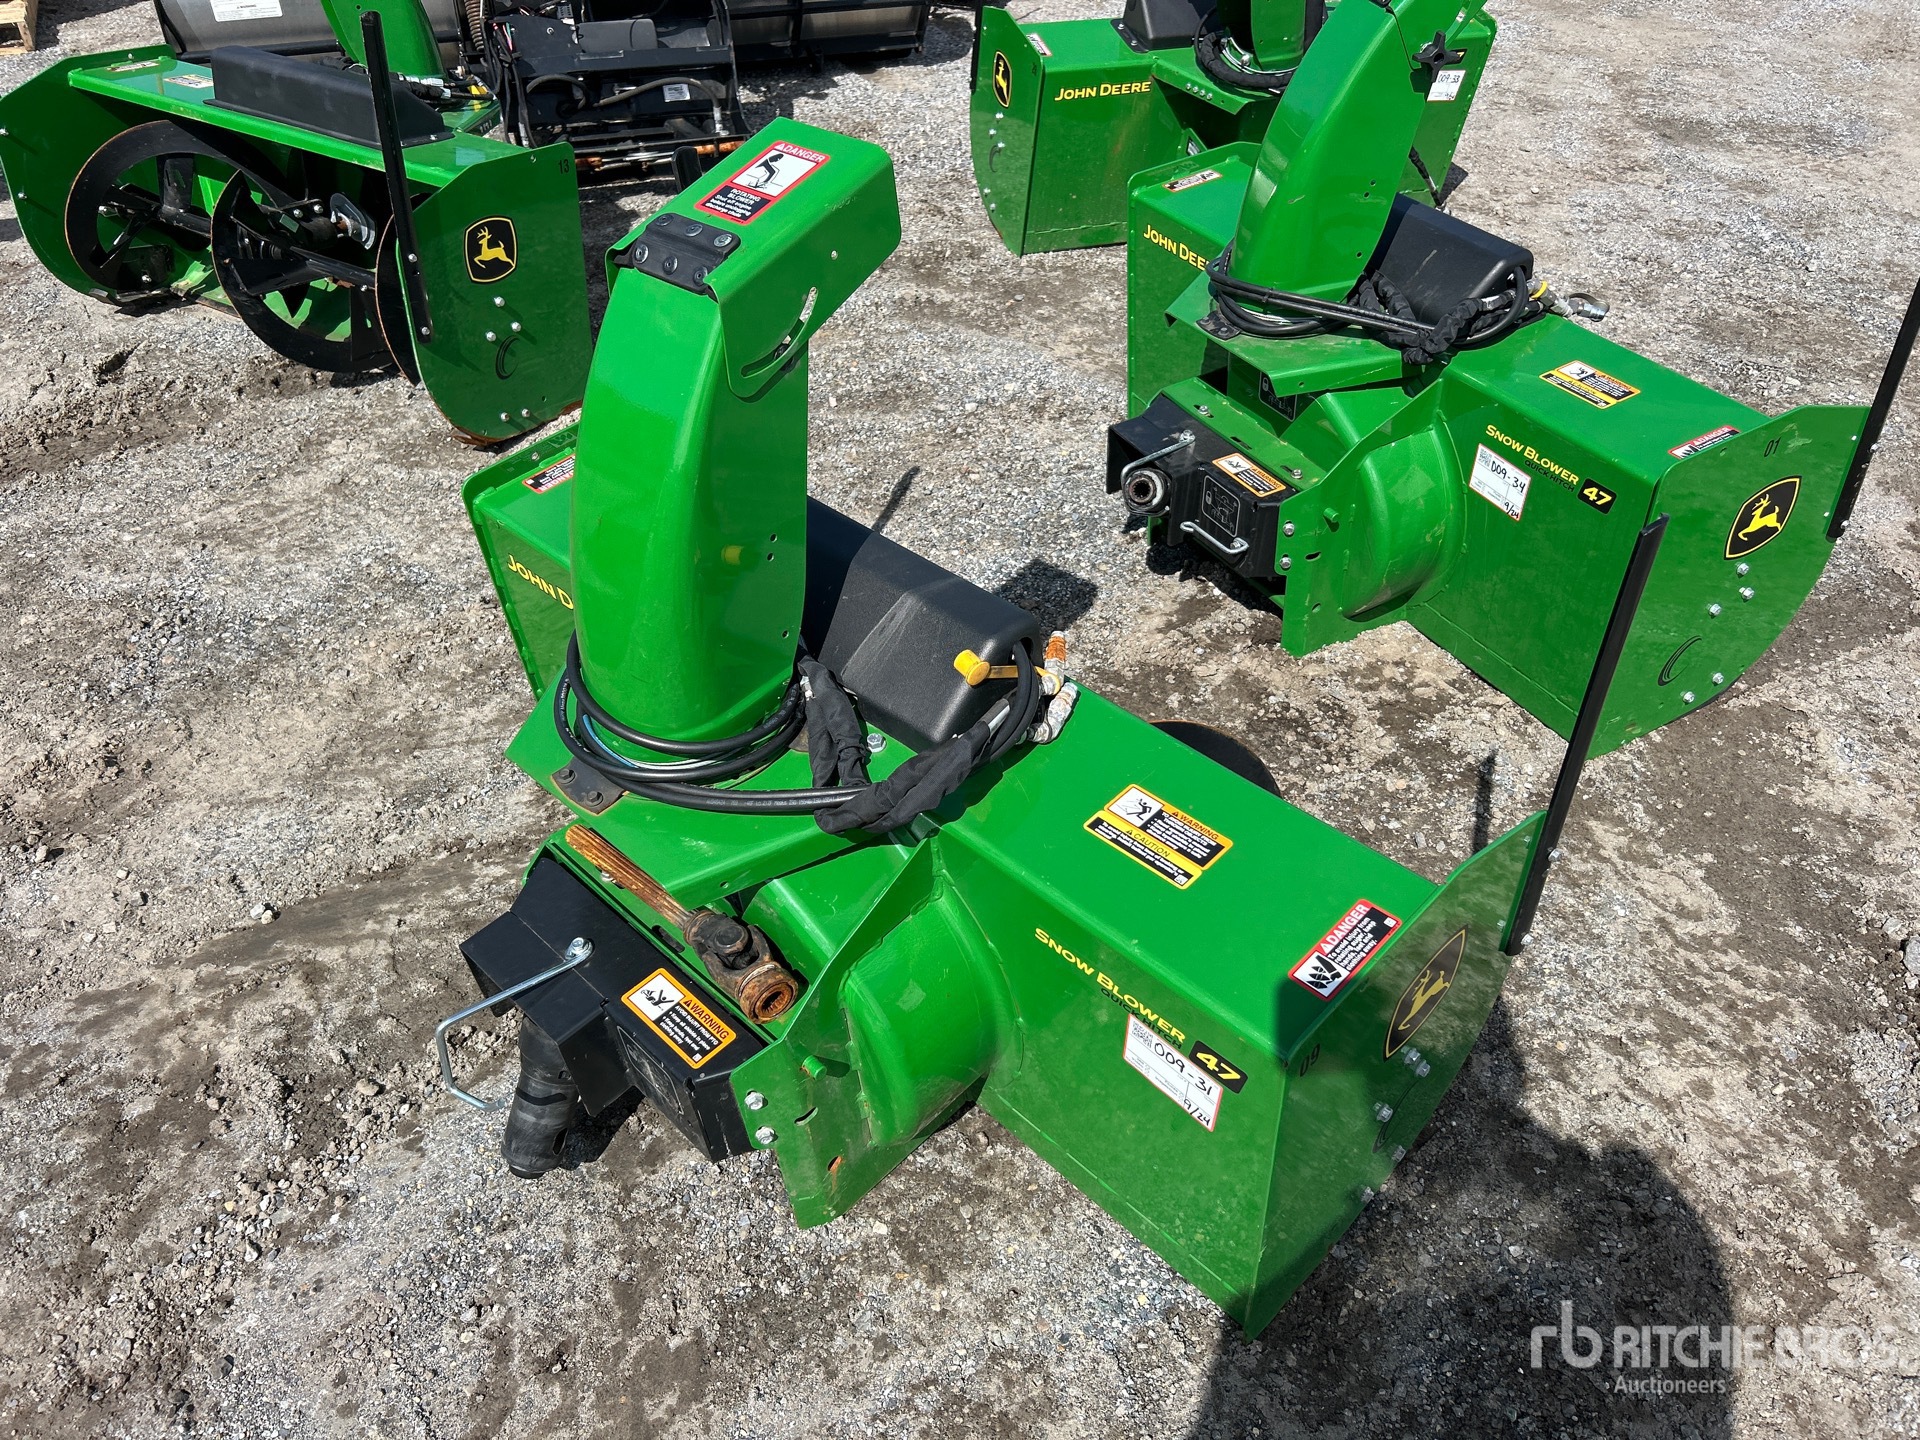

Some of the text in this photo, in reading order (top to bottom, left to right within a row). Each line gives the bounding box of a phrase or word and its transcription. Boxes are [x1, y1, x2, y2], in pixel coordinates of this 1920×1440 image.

[1055, 81, 1151, 101] JOHN DEERE
[558, 159, 570, 175] 13
[784, 145, 825, 162] DANGER
[727, 193, 754, 204] BLOWER
[1144, 225, 1210, 271] JOHN DEE
[1700, 427, 1730, 444] DANGER
[1764, 437, 1781, 457] 01
[1486, 424, 1524, 452] SNOW
[1524, 446, 1580, 485] BLOWER
[1524, 460, 1549, 478] QUICK
[1550, 475, 1575, 492] HITCH
[1583, 487, 1612, 506] 47
[508, 554, 557, 600] JOHN
[1180, 816, 1220, 840] WARNING
[1134, 833, 1170, 857] CAUTION
[1326, 904, 1369, 945] DANGER
[1334, 940, 1349, 953] avoid
[1346, 927, 1362, 942] injury
[1358, 917, 1370, 928] from
[1334, 945, 1354, 964] rotating
[1363, 921, 1378, 933] keep
[1354, 942, 1365, 952] feet
[1362, 933, 1373, 943] and
[1346, 951, 1366, 971] clothing
[1034, 928, 1094, 975] SNOW
[1096, 972, 1186, 1043] BLOWER
[660, 1022, 675, 1036] clothing
[670, 1013, 681, 1023] Keep
[684, 1026, 698, 1038] shields
[700, 1040, 711, 1051] place
[675, 1005, 719, 1045] AVOID INJURY FROM PTO
[690, 1004, 730, 1040] WARNING
[1100, 988, 1140, 1018] QUICK
[1142, 1018, 1182, 1049] HITCH
[664, 1018, 675, 1028] Keep
[691, 1043, 700, 1051] and
[1196, 1052, 1241, 1080] 47
[1300, 1043, 1320, 1077] 09
[1184, 1098, 1211, 1126] 9/24
